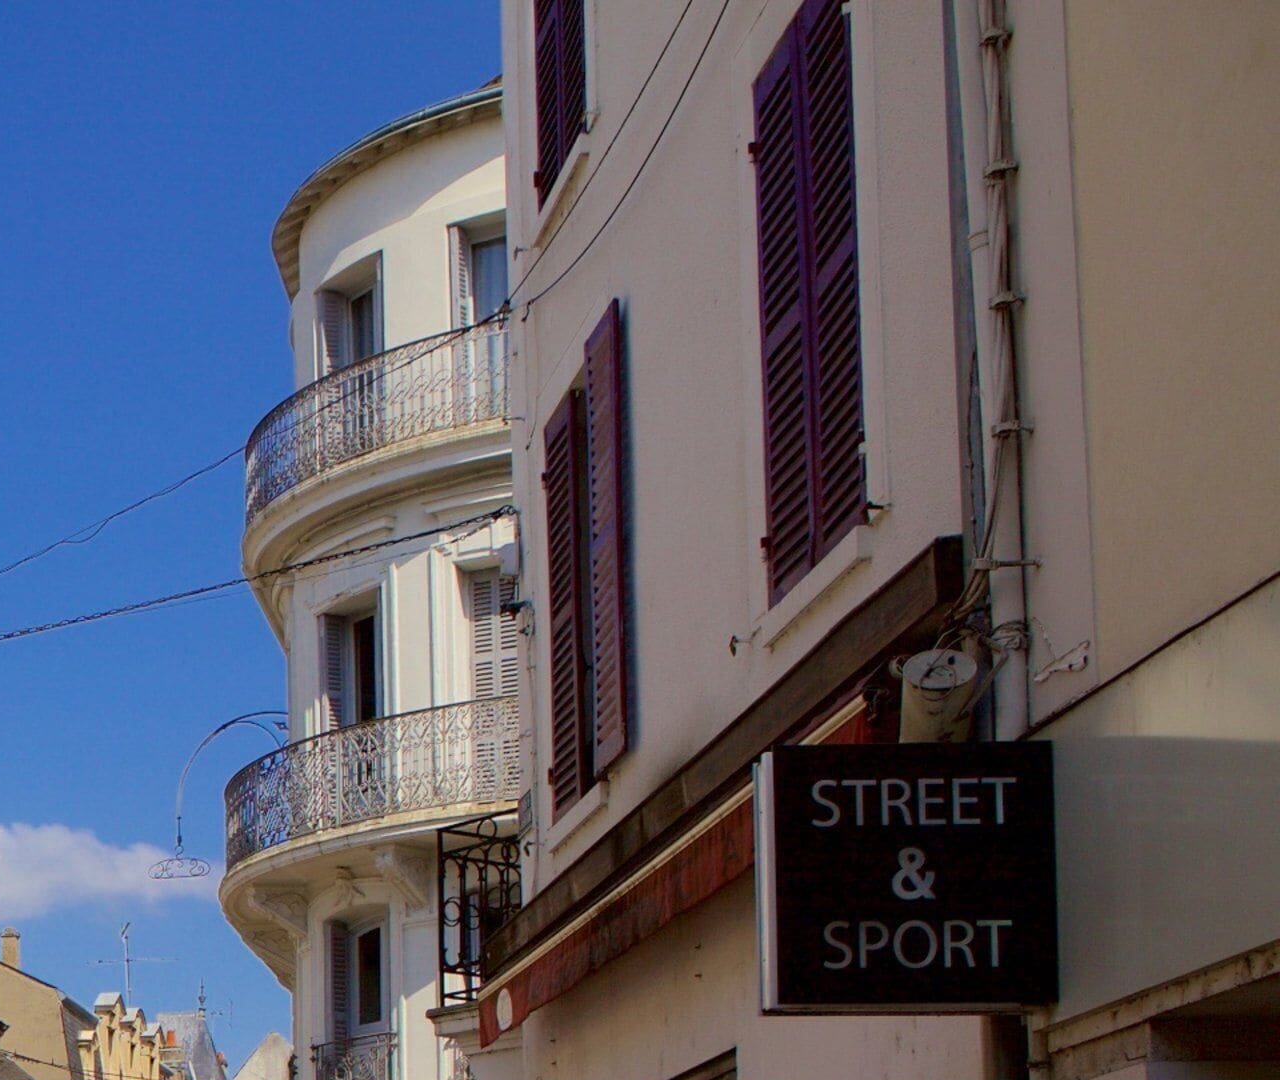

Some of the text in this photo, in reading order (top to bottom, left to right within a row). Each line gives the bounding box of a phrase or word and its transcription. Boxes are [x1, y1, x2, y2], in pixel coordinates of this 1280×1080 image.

[811, 777, 1016, 828] STREET
[891, 847, 936, 900] &
[823, 920, 1013, 969] SPORT
